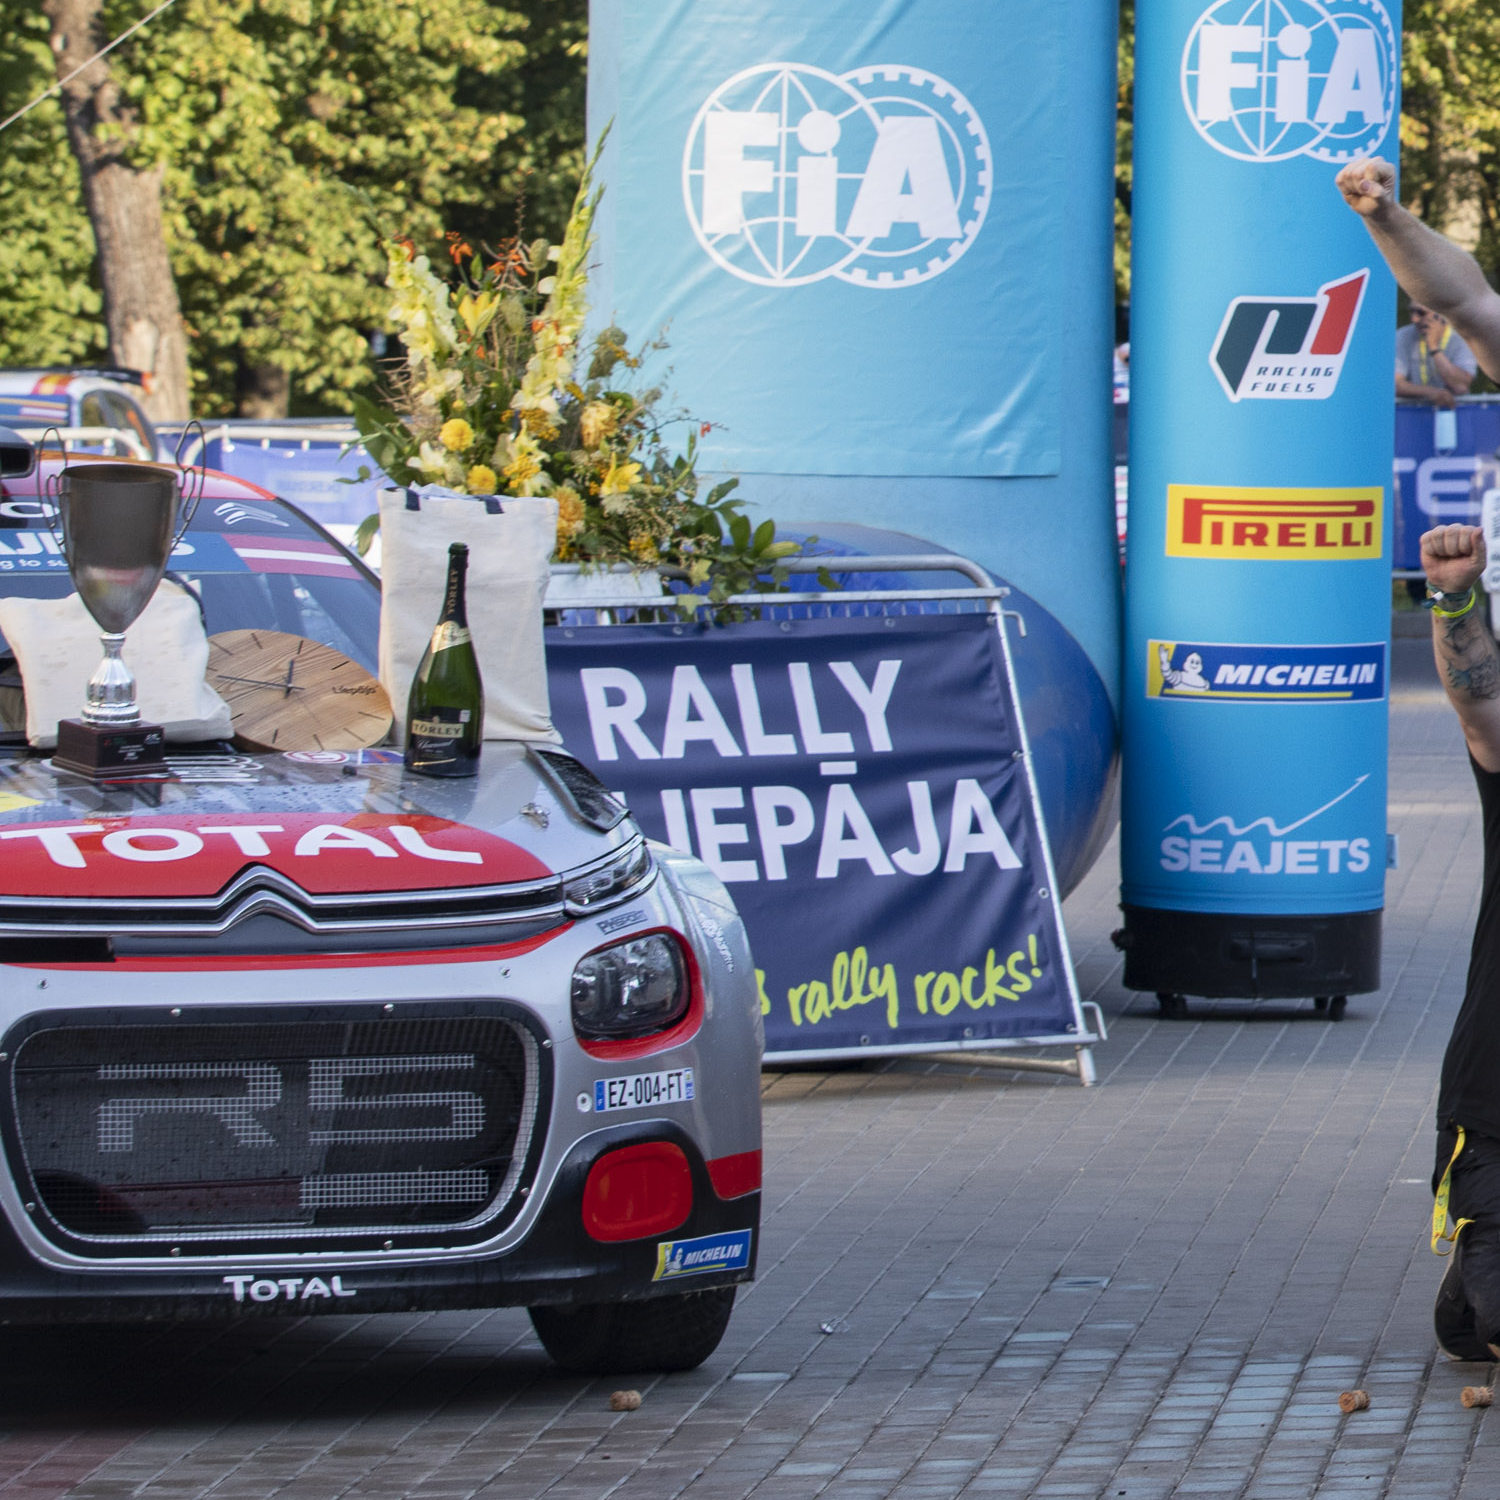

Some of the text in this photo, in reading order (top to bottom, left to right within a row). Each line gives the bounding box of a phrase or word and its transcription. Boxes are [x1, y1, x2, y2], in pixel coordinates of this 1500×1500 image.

[1250, 380, 1317, 395] FUELS
[1257, 364, 1334, 380] RACING
[1181, 498, 1376, 549] PIRELLI
[1213, 661, 1378, 687] MICHELIN
[579, 659, 902, 761] RALLY
[611, 761, 1024, 883] IEPĀJA
[0, 823, 484, 870] TOTAL
[1159, 836, 1372, 877] SEAJETS
[788, 946, 900, 1030] rally
[914, 934, 1043, 1018] rocks!
[96, 1053, 487, 1153] R5
[608, 1072, 683, 1109] EZ-004-FT
[682, 1243, 744, 1267] MICHELIN
[222, 1274, 357, 1302] TOTAL
